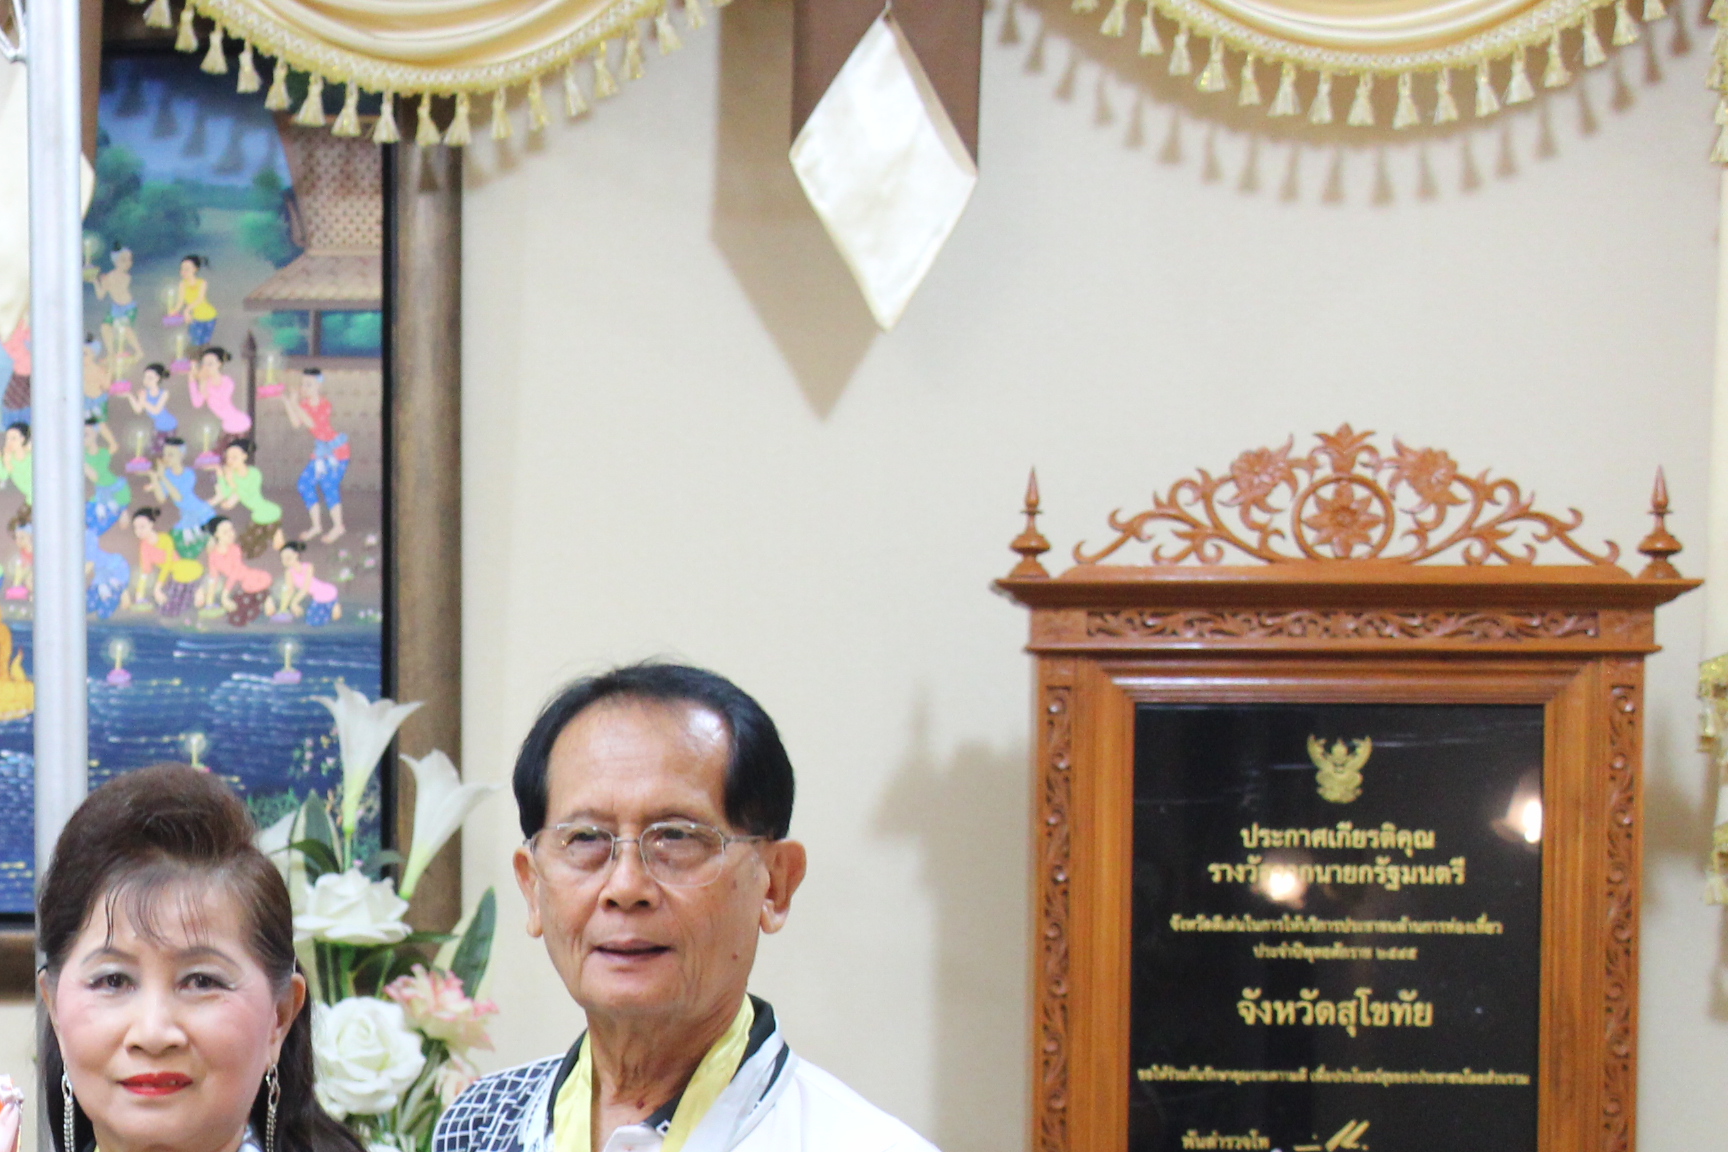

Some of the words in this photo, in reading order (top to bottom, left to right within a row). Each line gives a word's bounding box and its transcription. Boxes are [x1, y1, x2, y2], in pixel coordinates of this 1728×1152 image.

[1240, 821, 1436, 858] ประกาศเกียรติคุณ
[1208, 856, 1467, 890] รางวักนายกรัฐมนตรี
[1237, 988, 1433, 1038] จังหวัดสุโขทัย
